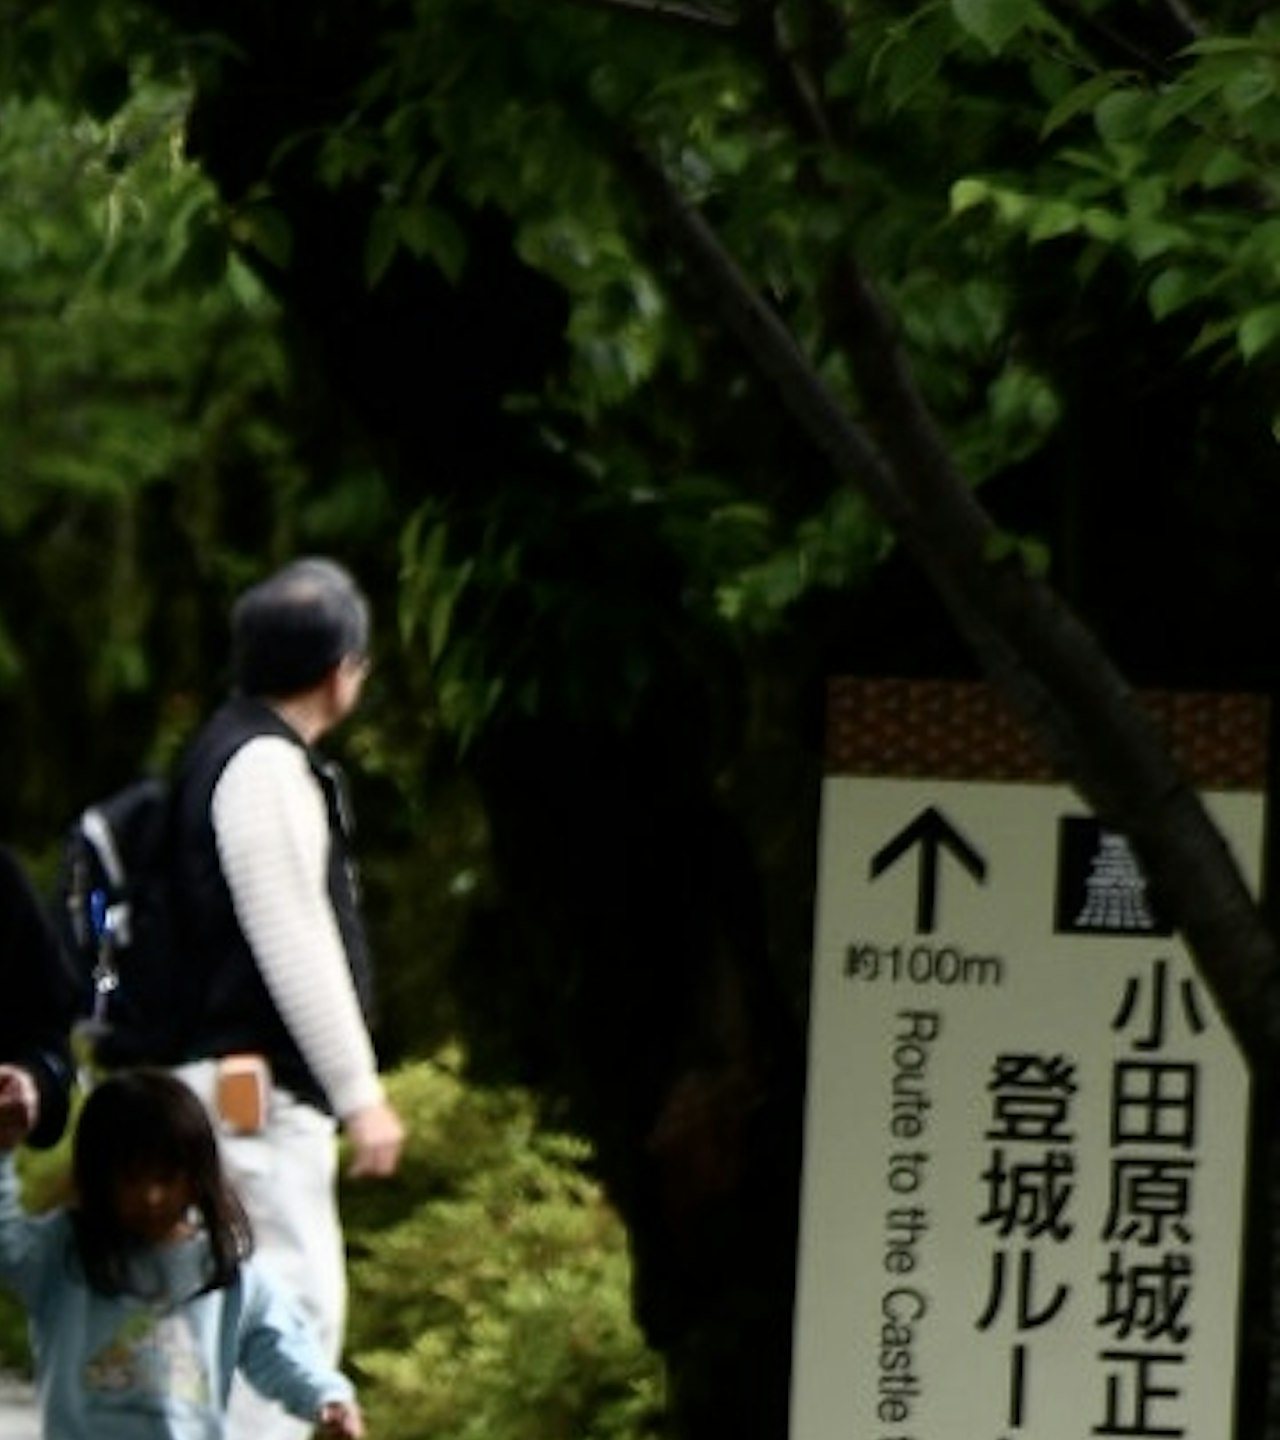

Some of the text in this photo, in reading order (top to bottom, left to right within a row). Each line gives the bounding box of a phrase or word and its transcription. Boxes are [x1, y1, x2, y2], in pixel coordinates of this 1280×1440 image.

[843, 943, 1004, 986] 約100m
[891, 1009, 941, 1140] Route
[887, 1153, 930, 1194] to
[883, 1208, 930, 1275] the
[875, 1287, 927, 1425] Castle
